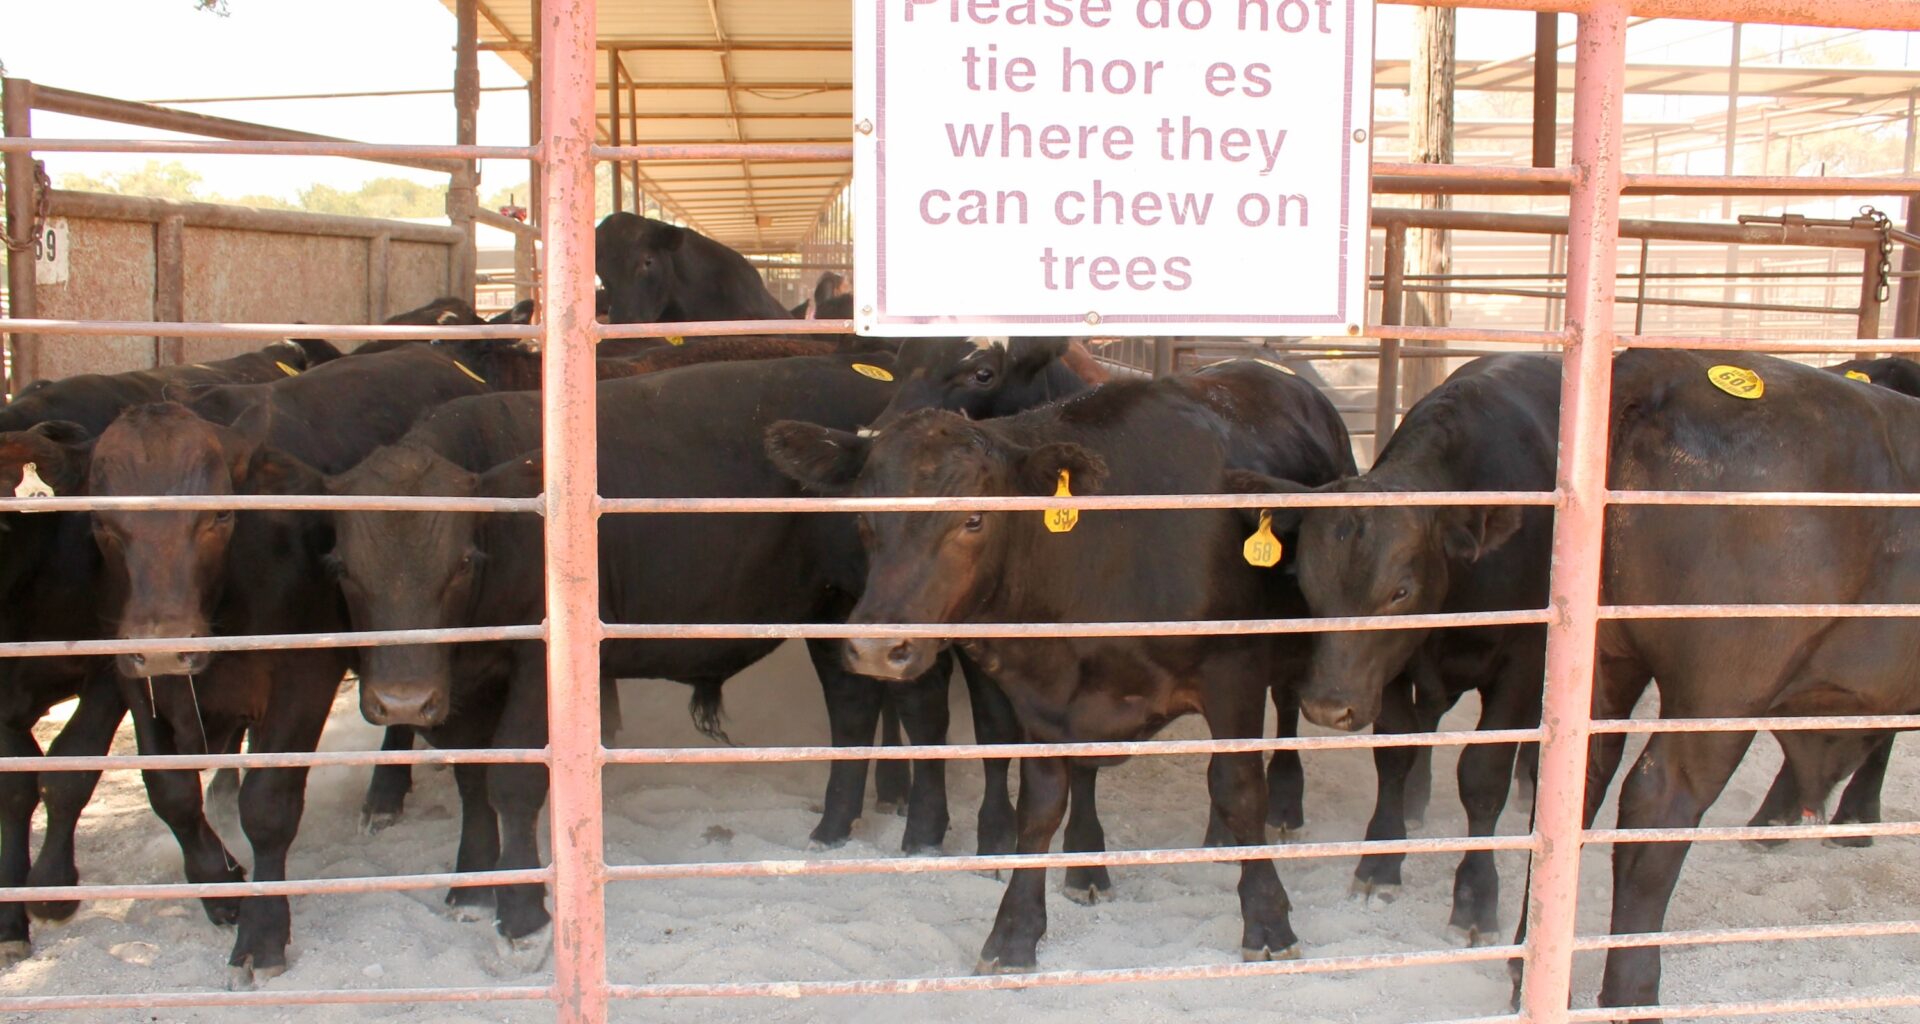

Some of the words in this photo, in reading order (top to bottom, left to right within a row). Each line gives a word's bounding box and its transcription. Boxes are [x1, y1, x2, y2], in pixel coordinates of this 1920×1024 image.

[1136, 0, 1211, 30] do
[1238, 0, 1332, 34] not
[962, 44, 1036, 92] tie
[945, 112, 1133, 160] where
[1157, 116, 1287, 176] they
[920, 189, 1028, 225] can
[1055, 180, 1214, 226] chew
[1237, 193, 1308, 227] on
[1040, 247, 1192, 291] trees
[1719, 371, 1757, 392] 604
[1252, 541, 1272, 562] 58
